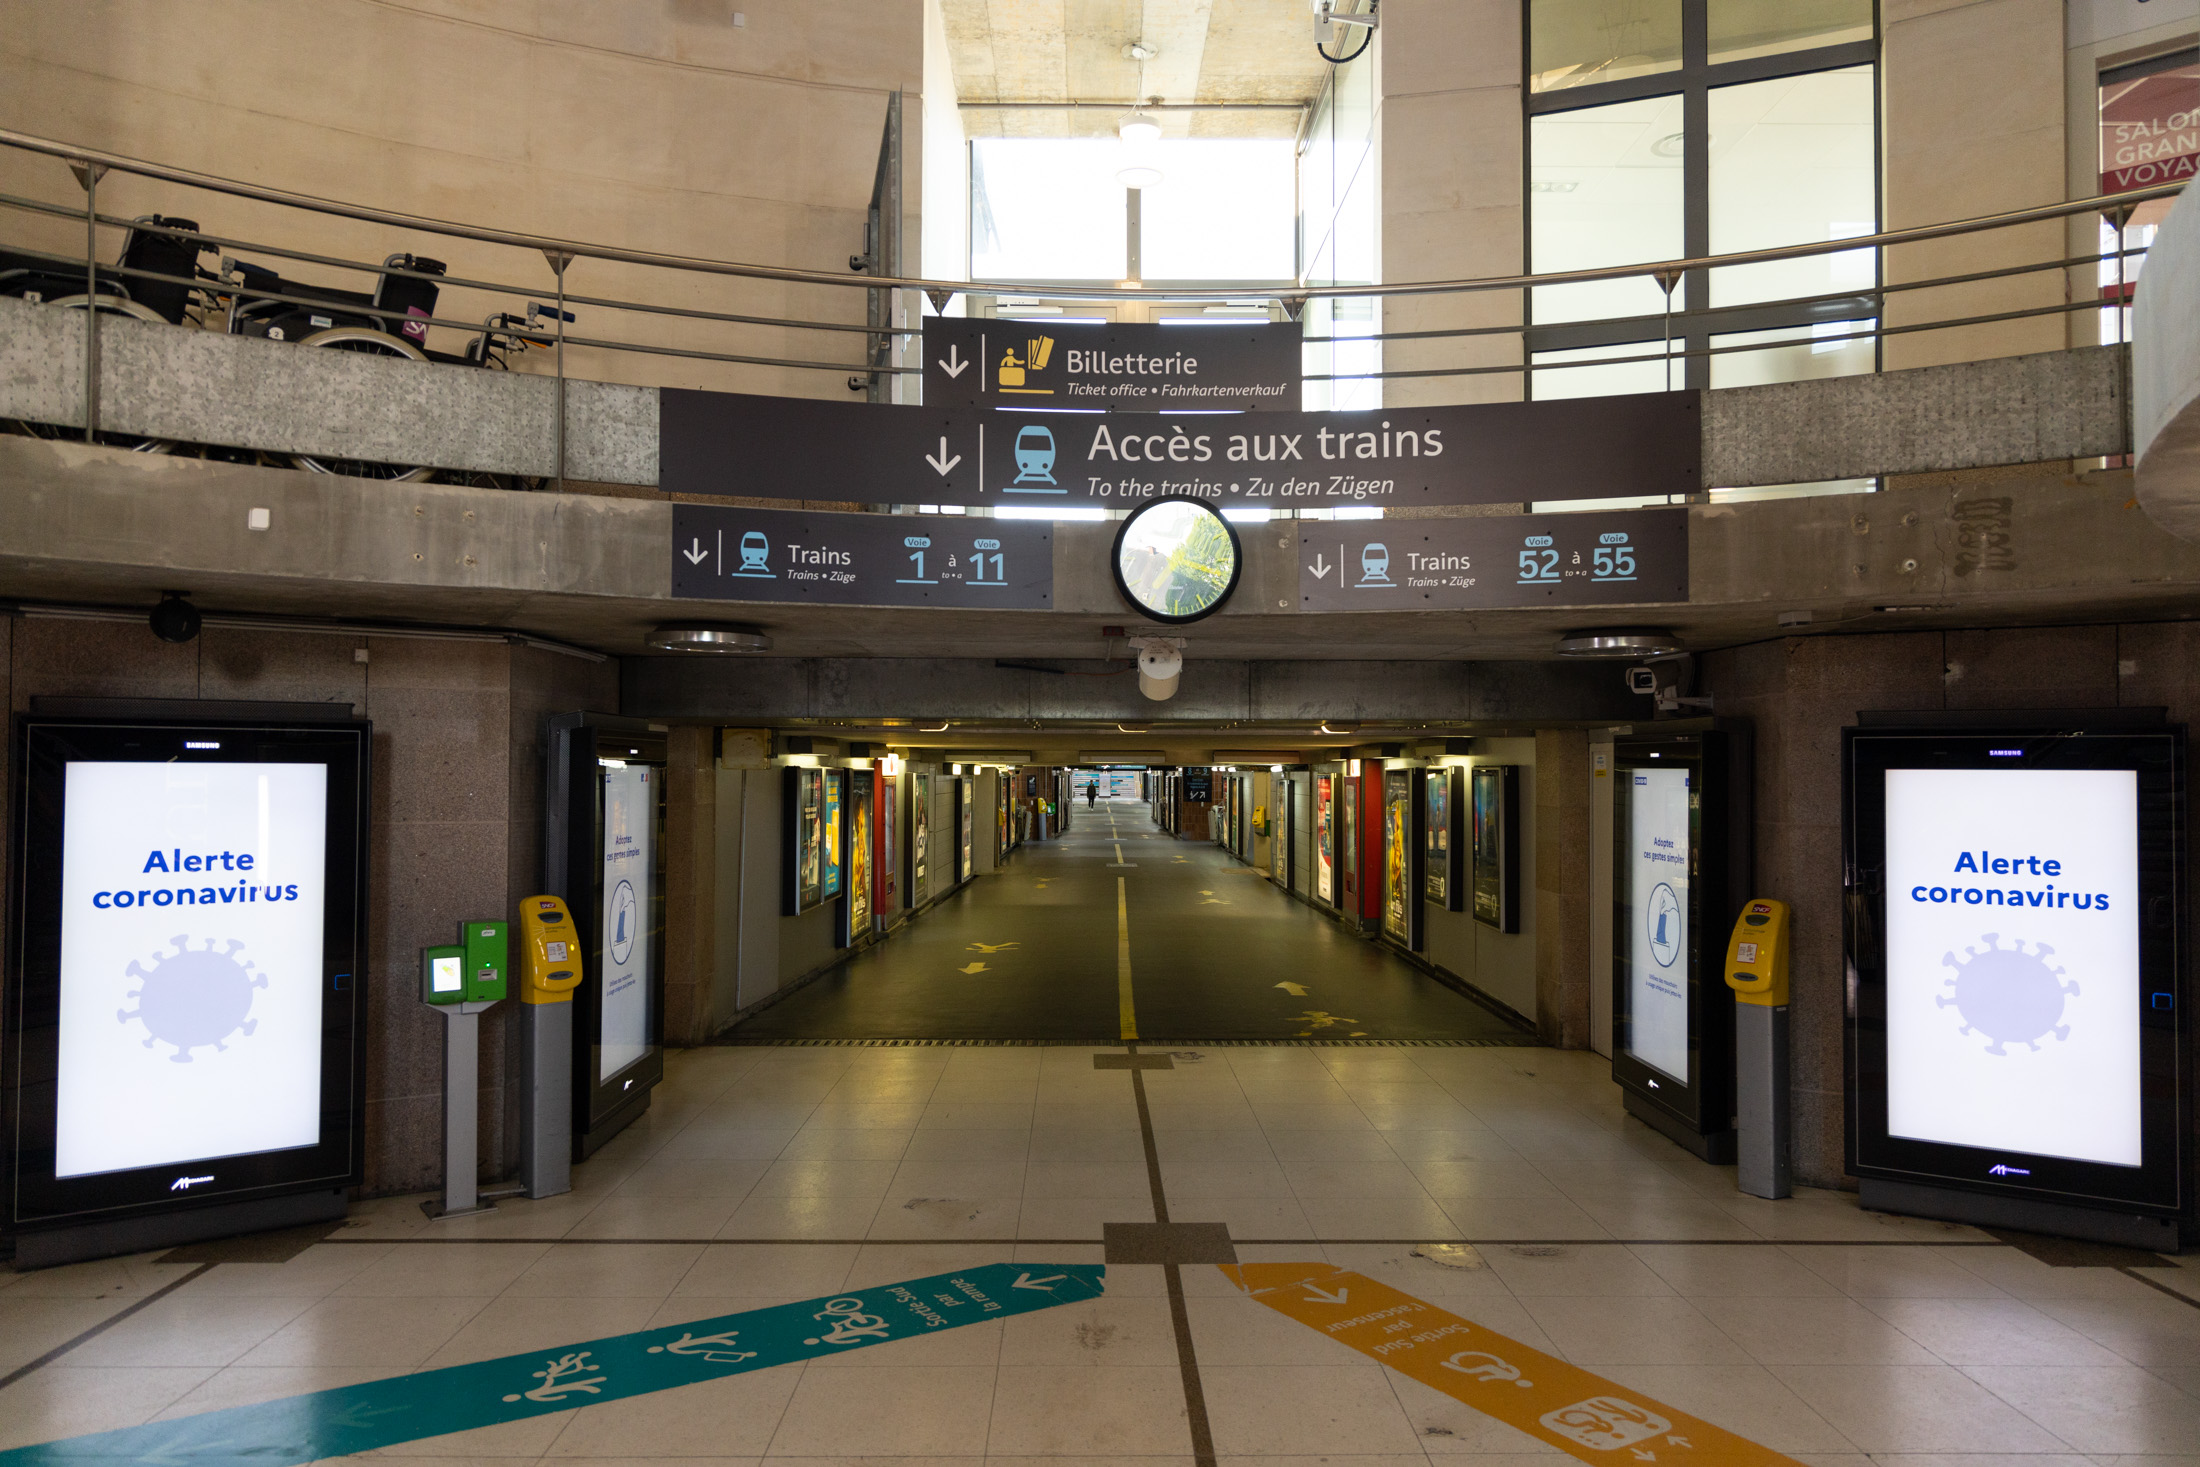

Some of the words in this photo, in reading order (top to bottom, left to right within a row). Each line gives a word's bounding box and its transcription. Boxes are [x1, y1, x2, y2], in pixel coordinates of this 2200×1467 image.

[1066, 349, 1198, 376] Billetterie
[1067, 382, 1106, 396] Ticket
[1109, 382, 1147, 397] office
[1161, 382, 1287, 398] Fahrkartenverkauf
[1087, 425, 1213, 462] Accès
[1226, 434, 1303, 461] aux
[1316, 421, 1444, 460] trains
[1088, 477, 1113, 497] To
[1117, 477, 1155, 497] the
[1160, 477, 1223, 498] trains
[1245, 477, 1275, 497] Zu
[1280, 476, 1320, 496] den
[1326, 475, 1395, 501] Zügen
[908, 538, 929, 547] Voie
[977, 540, 997, 549] Voie
[1529, 537, 1550, 546] Voie
[1604, 534, 1624, 543] Voie
[788, 544, 852, 566] Trains
[1407, 552, 1471, 571] Trains
[1519, 550, 1560, 578] 52
[1572, 552, 1581, 565] à
[1593, 547, 1636, 576] 55
[909, 551, 924, 578] 1
[948, 554, 957, 567] à
[969, 552, 1004, 580] 11
[787, 569, 820, 582] Trains
[829, 570, 857, 584] Züge
[942, 571, 951, 579] to
[1407, 576, 1439, 588] Trains
[1449, 575, 1477, 589] Züge
[1653, 837, 1674, 850] Adoptez
[143, 849, 254, 873] Alerte
[1643, 851, 1651, 859] ces
[1652, 852, 1666, 862] gestes
[1667, 853, 1685, 866] simples
[1954, 851, 2062, 877] Alerte
[92, 880, 299, 909] coronavirus
[1911, 881, 2110, 911] coronavirus
[1988, 1164, 2031, 1175] MEDIAGARE
[885, 1286, 917, 1303] Sud
[950, 1278, 991, 1303] rampe
[933, 1293, 966, 1307] par
[983, 1301, 1002, 1312] la
[908, 1301, 948, 1327] Sortie
[1324, 1302, 1429, 1333] l'ascenseur
[1381, 1319, 1414, 1334] par
[1410, 1323, 1471, 1342] Sortie
[1372, 1338, 1416, 1355] Sud
